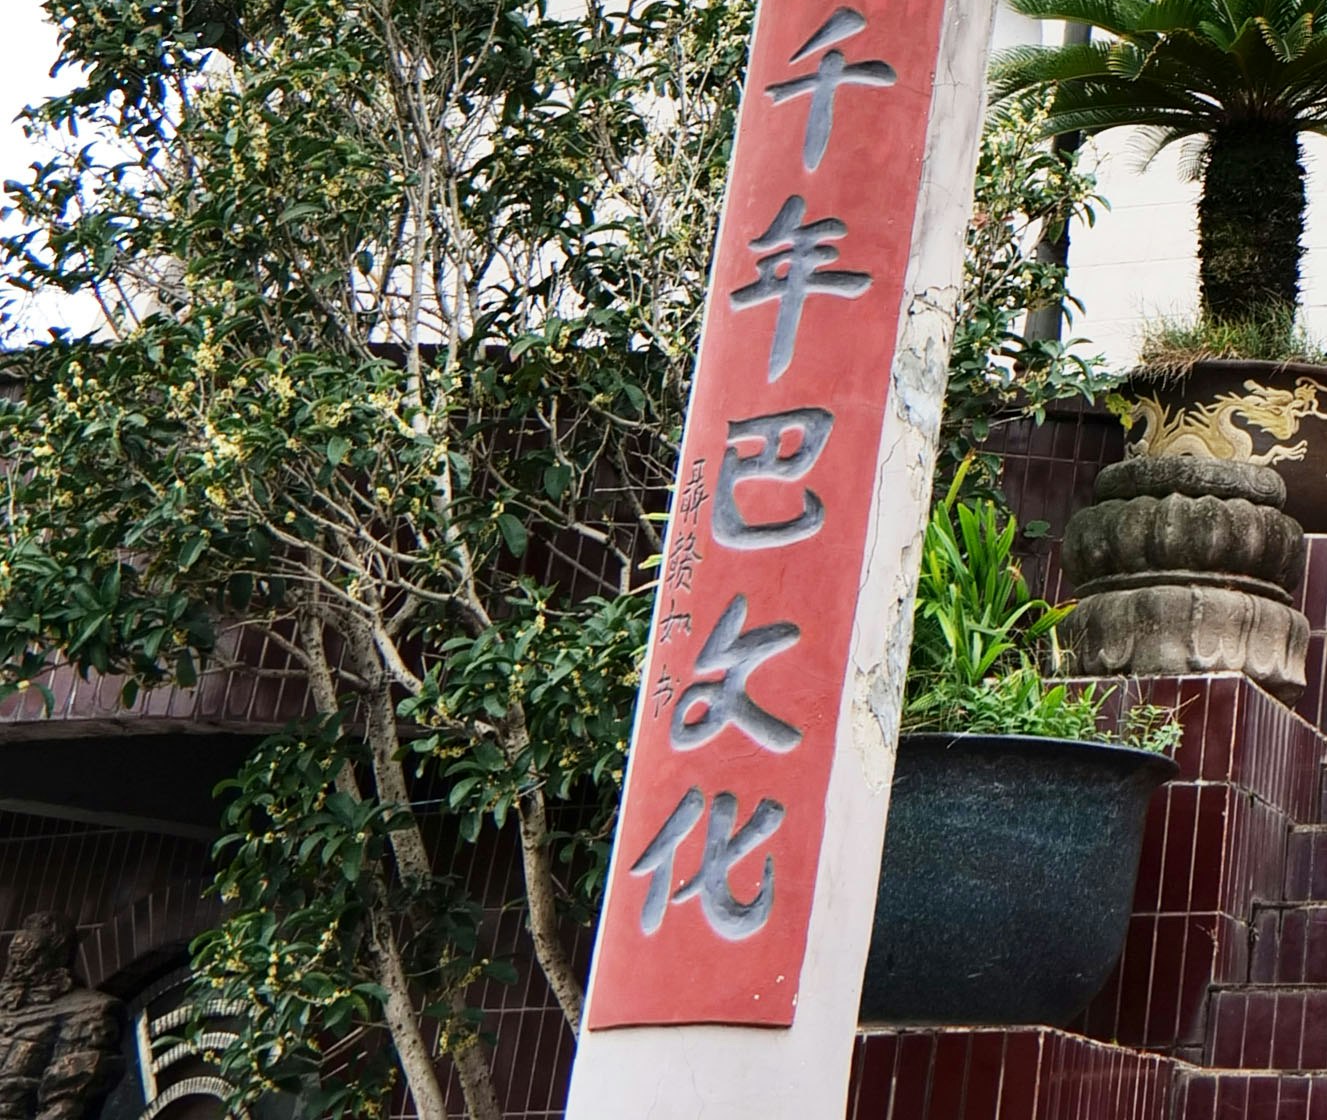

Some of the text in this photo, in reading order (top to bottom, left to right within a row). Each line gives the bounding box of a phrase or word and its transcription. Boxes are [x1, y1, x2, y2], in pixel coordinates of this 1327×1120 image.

[628, 5, 899, 942] 千年巴文化
